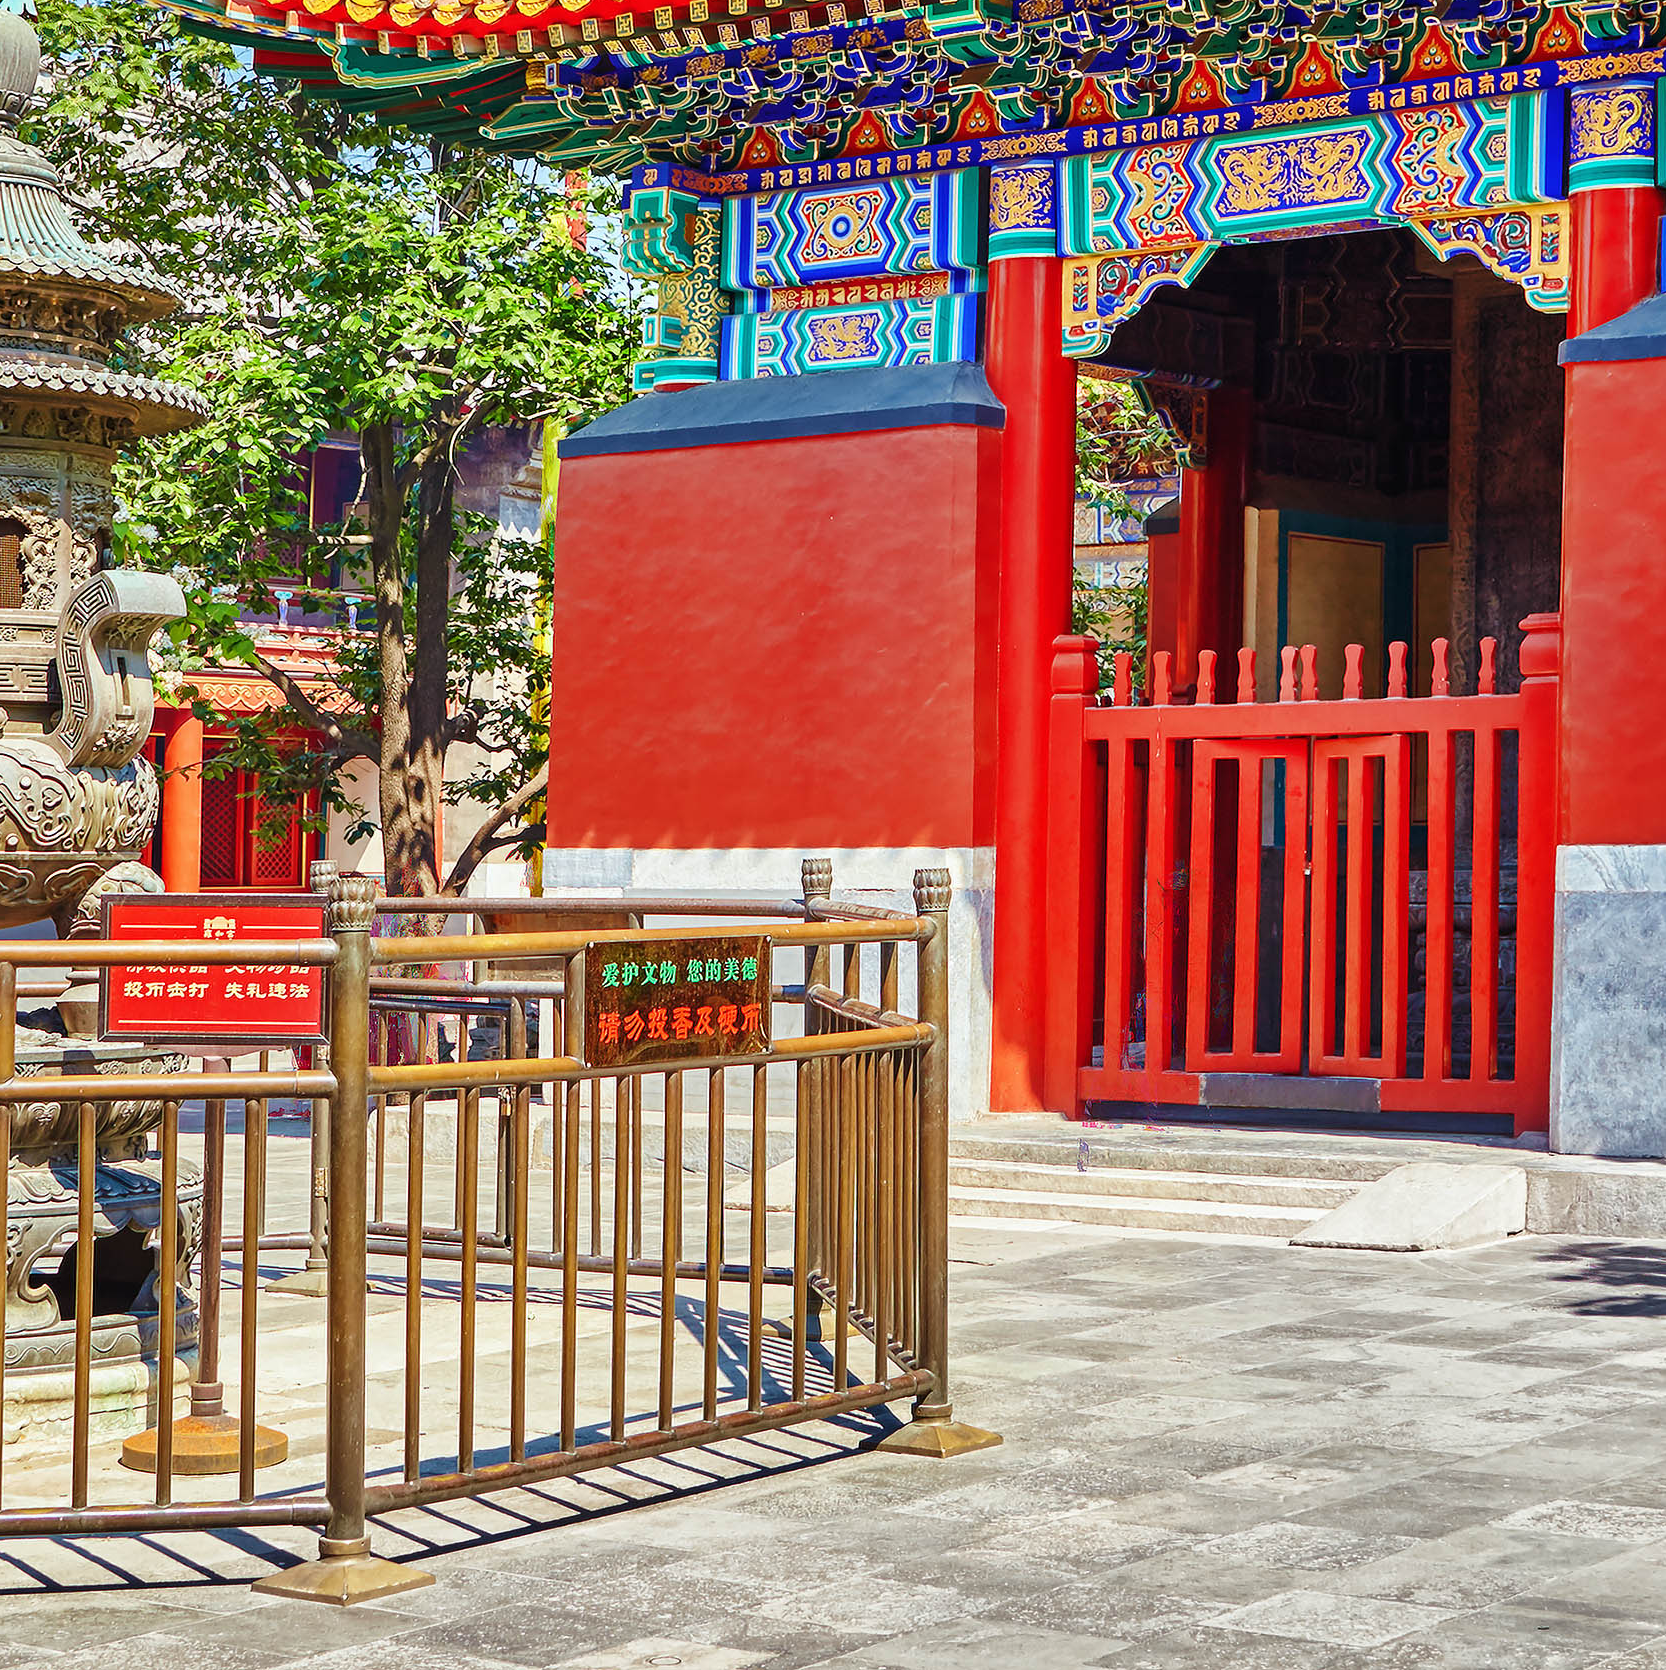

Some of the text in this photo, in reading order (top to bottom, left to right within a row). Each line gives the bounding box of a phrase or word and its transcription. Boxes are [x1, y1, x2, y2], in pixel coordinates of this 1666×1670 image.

[602, 956, 758, 988] 爱护文物 您的美德
[598, 1003, 762, 1044] 请勿投香及硬币
